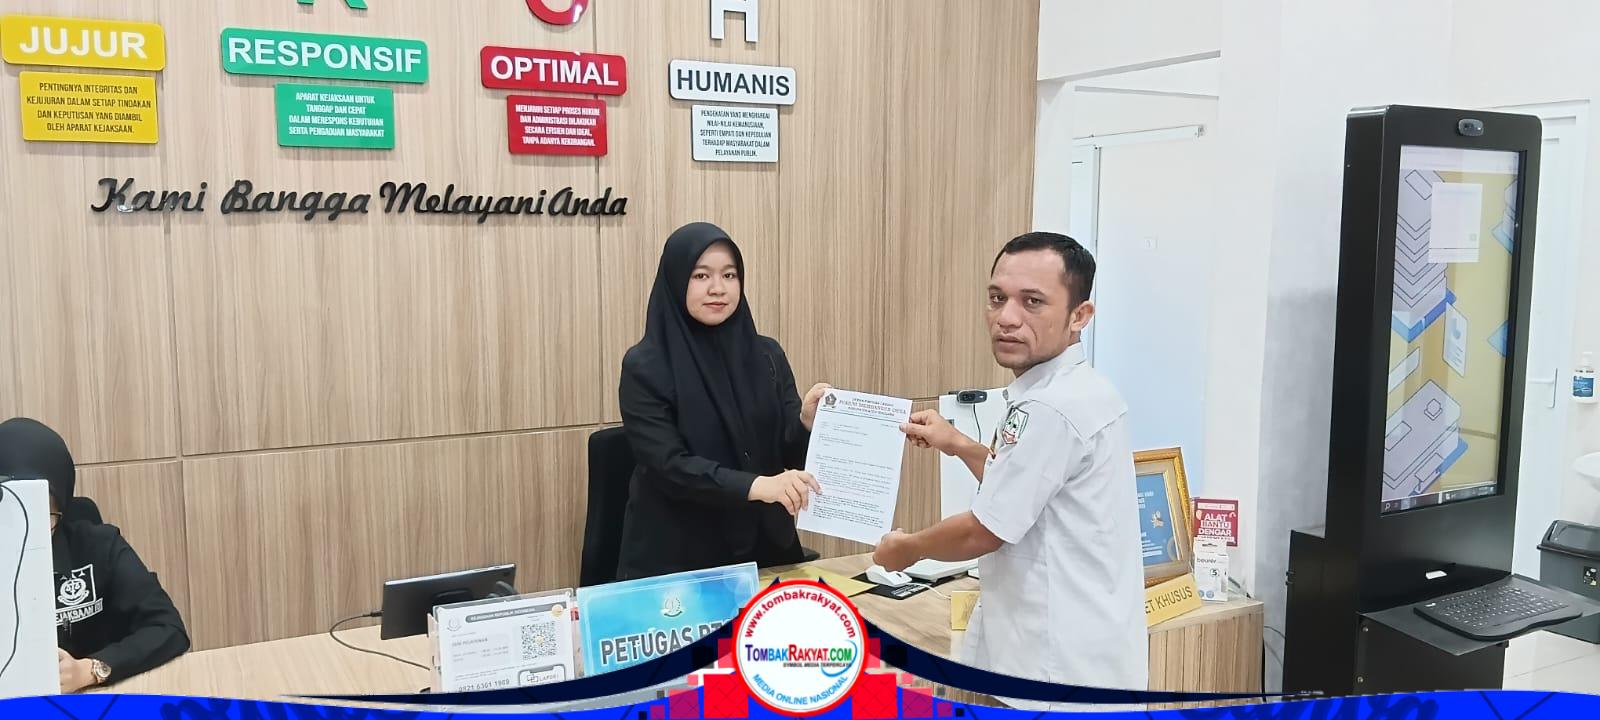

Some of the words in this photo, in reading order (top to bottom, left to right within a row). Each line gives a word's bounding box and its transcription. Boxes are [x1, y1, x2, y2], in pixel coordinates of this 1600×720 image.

[20, 26, 147, 59] JUJUR
[229, 37, 422, 73] RESPONSIF
[490, 55, 619, 87] OPTIMAL
[677, 69, 790, 96] HUMANIS
[40, 83, 82, 92] PENTINGNYA
[84, 84, 122, 94] INTEGRITAS
[124, 86, 138, 95] DAN
[27, 96, 65, 105] KEJUJURAN
[67, 97, 91, 106] DALAM
[92, 98, 116, 107] SETIAP
[118, 99, 152, 108] TINDAKAN
[296, 92, 319, 101] APARAT
[320, 93, 354, 103] KEJAKSAAN
[355, 96, 375, 104] UNTUK
[306, 104, 334, 113] TANGGAP
[335, 105, 348, 114] DAN
[348, 106, 366, 115] CEPAT
[543, 106, 561, 115] SETIAP
[729, 111, 741, 119] YANG
[38, 110, 52, 118] DAN
[53, 110, 94, 119] KEPUTUSAN
[95, 112, 113, 120] YANG
[114, 113, 142, 122] DIAMBIL
[289, 115, 311, 124] DALAM
[311, 116, 348, 125] MERESPONS
[349, 117, 384, 126] KEBUTUHAN
[520, 115, 531, 123] DAN
[47, 123, 65, 131] OLEH
[66, 123, 92, 132] APARAT
[93, 124, 135, 133] KEJAKSAAN.
[289, 127, 308, 135] SERTA
[309, 127, 345, 137] PENGADUAN
[346, 128, 384, 137] MASYARAKAT
[525, 125, 545, 134] SECARA
[566, 127, 577, 135] DAN
[700, 129, 718, 137] SEPERTI
[735, 130, 745, 138] DAN
[522, 136, 539, 144] TANPA
[540, 136, 561, 145] ADANYA
[702, 139, 725, 147] TERHADAP
[91, 177, 207, 213] Kami
[220, 179, 370, 221] Bangga
[379, 181, 547, 224] Melayani
[548, 186, 627, 216] Anda
[1204, 513, 1228, 522] ALAT
[1200, 520, 1232, 529] BANTU
[1198, 527, 1232, 537] DENGAR
[1155, 586, 1193, 609] KHUSUS
[601, 627, 693, 664] PETUGAS
